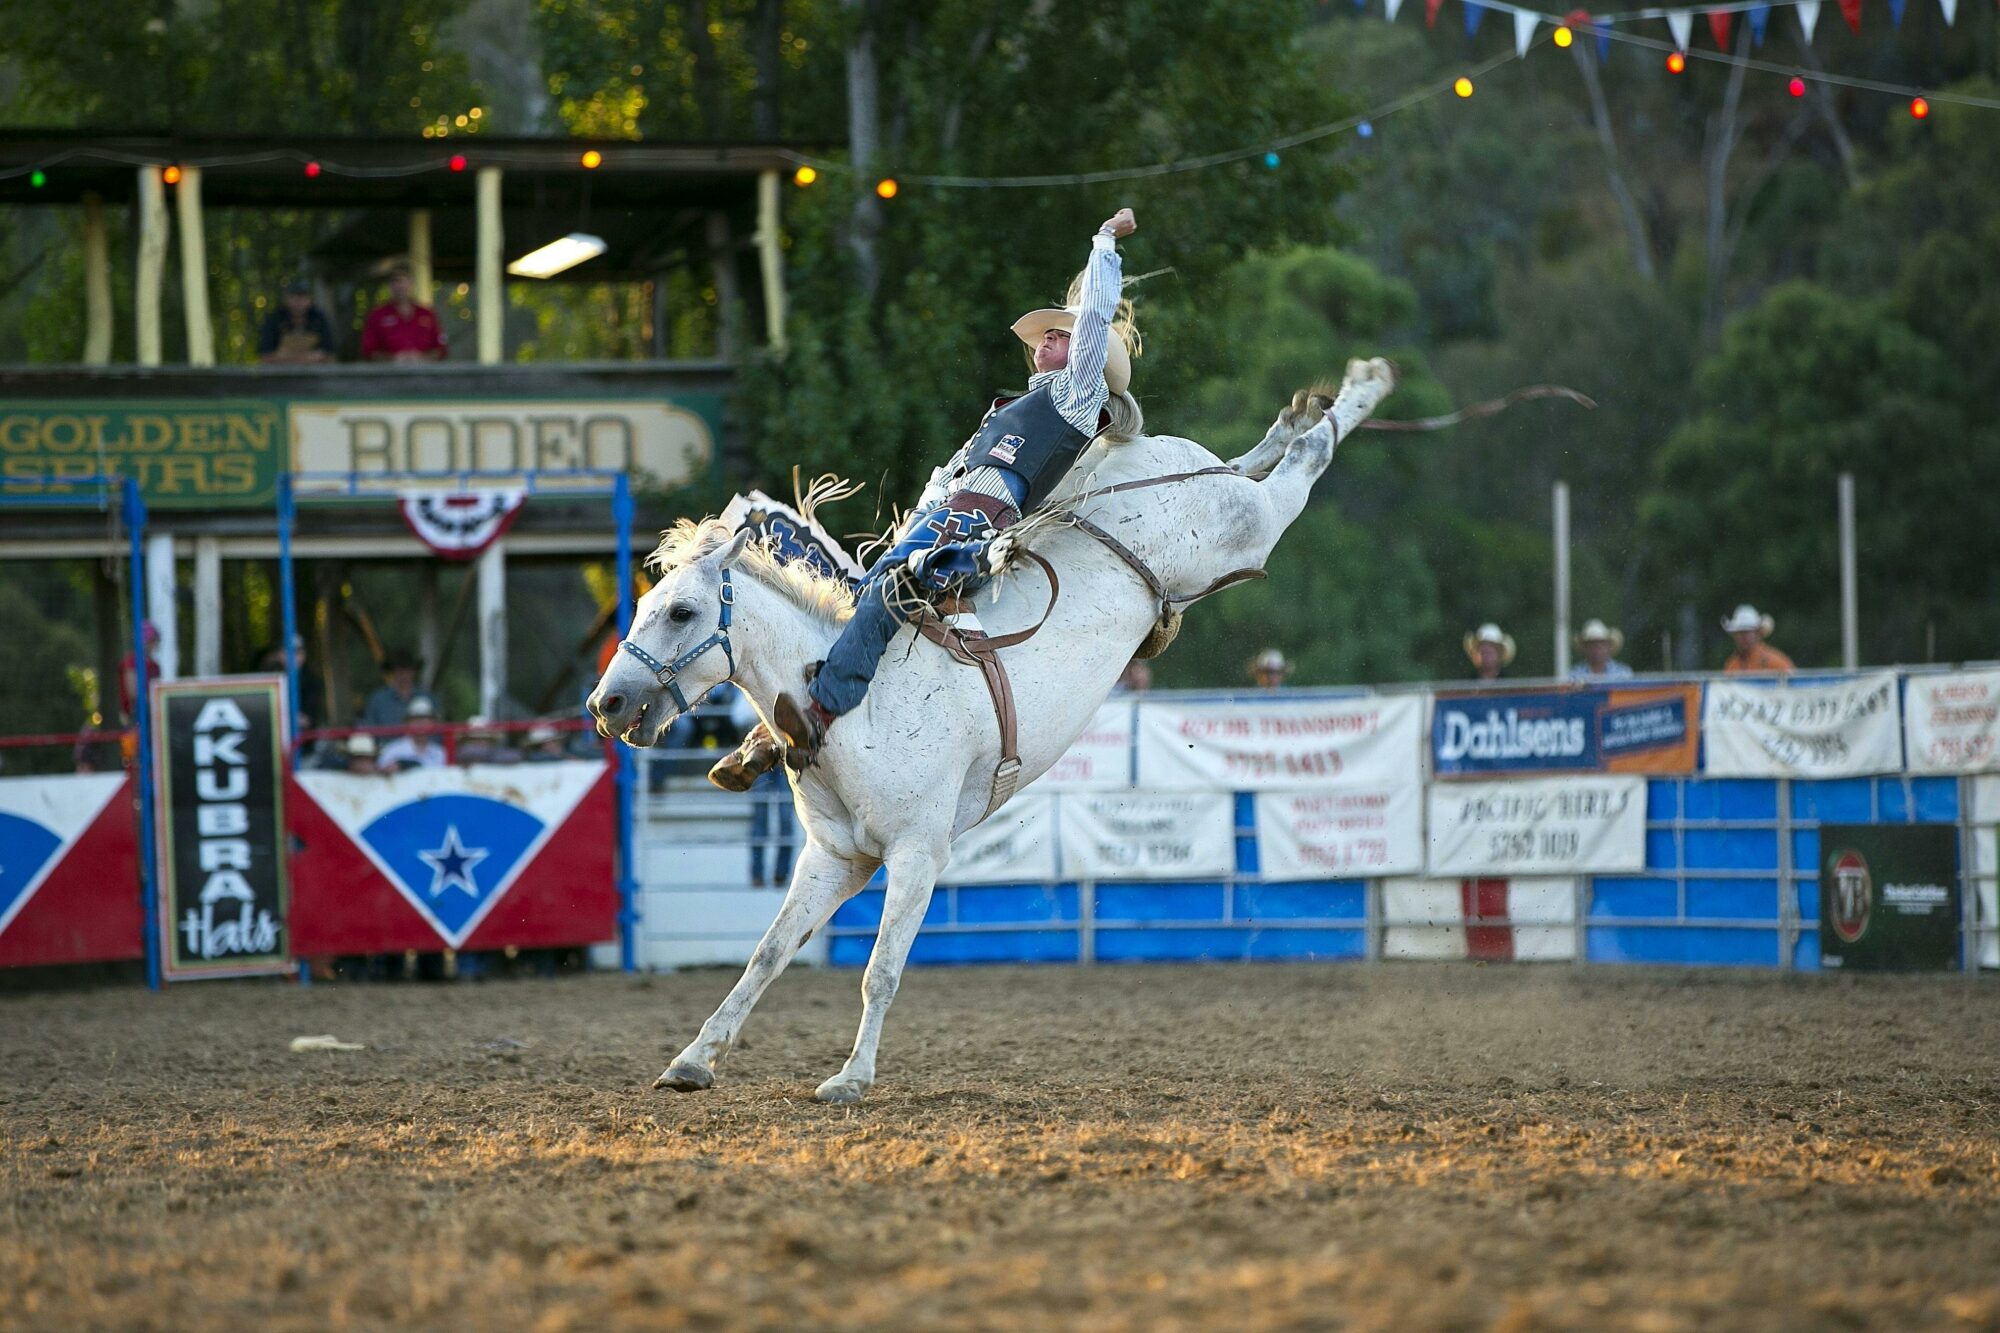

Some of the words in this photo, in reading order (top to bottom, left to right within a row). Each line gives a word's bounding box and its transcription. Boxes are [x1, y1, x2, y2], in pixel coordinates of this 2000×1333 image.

[0, 413, 276, 451] GOLDEN
[341, 413, 632, 477] RODEO
[2, 453, 258, 493] SPURS
[1438, 708, 1586, 759] Dahlsens
[193, 698, 256, 904] AKUBRA
